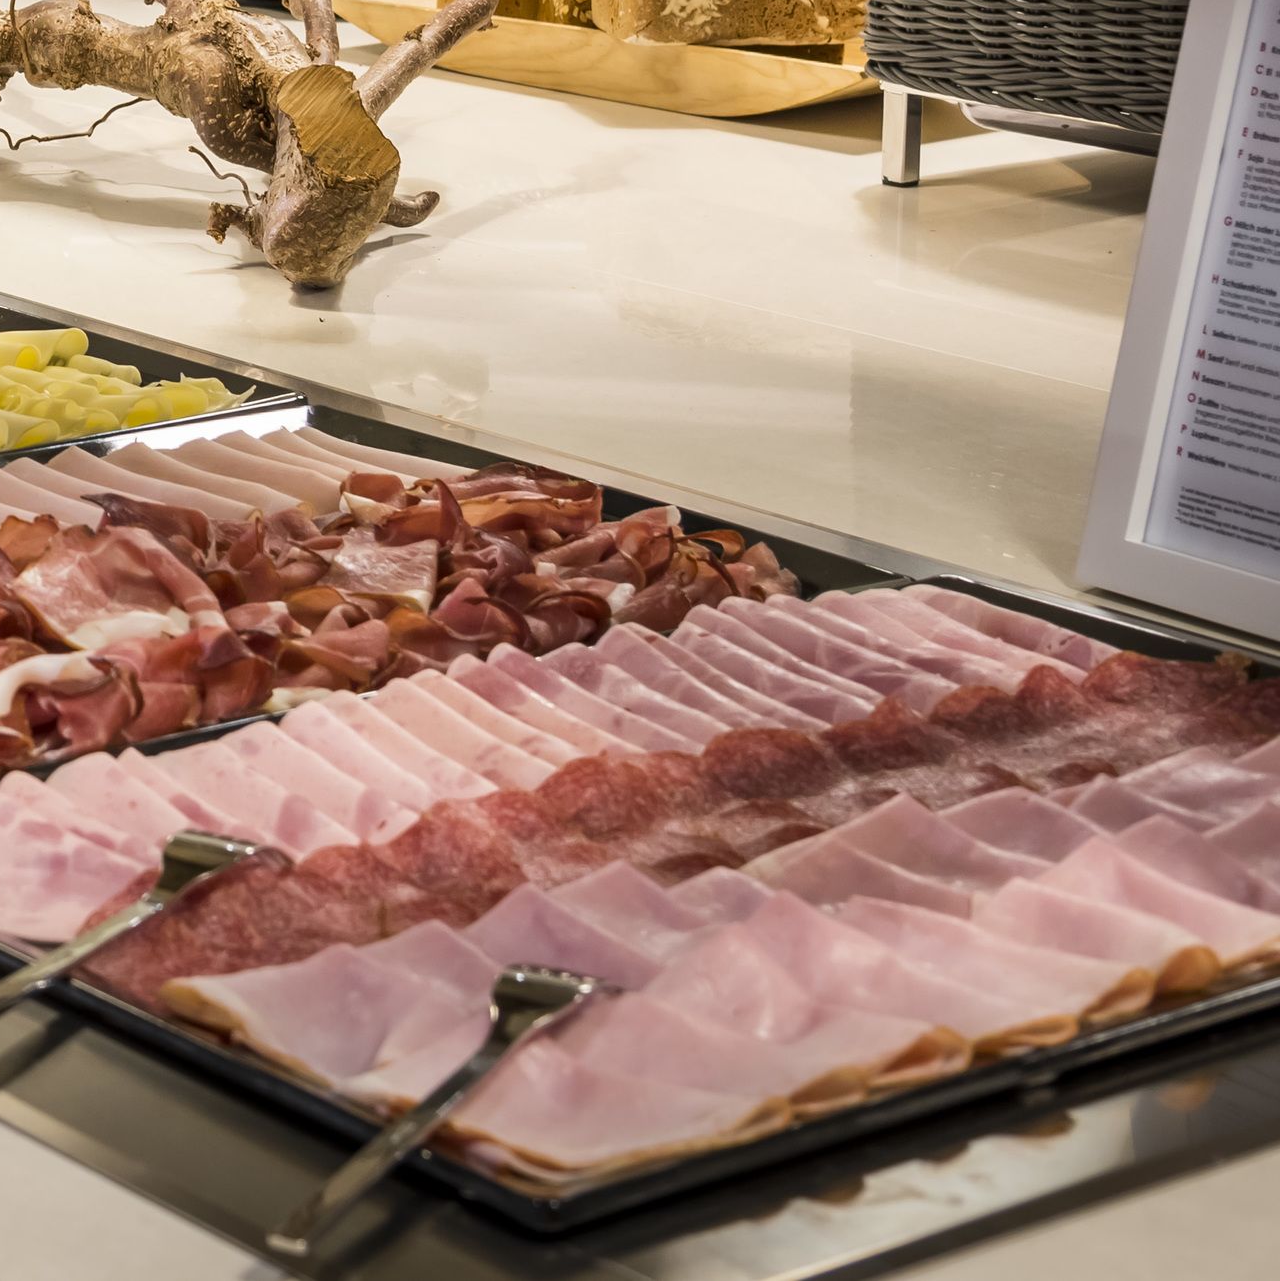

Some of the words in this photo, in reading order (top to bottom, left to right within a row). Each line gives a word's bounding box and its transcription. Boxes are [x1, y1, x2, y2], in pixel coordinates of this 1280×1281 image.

[1255, 64, 1264, 74] C
[1251, 86, 1259, 96] D
[1242, 127, 1248, 137] E
[1237, 149, 1244, 158] F
[1223, 216, 1232, 226] G
[1212, 274, 1220, 284] H
[1202, 325, 1207, 335] L
[1196, 349, 1205, 359] M
[1192, 371, 1200, 381] N
[1187, 392, 1196, 403] O
[1181, 424, 1187, 433] P
[1176, 446, 1183, 456] R
